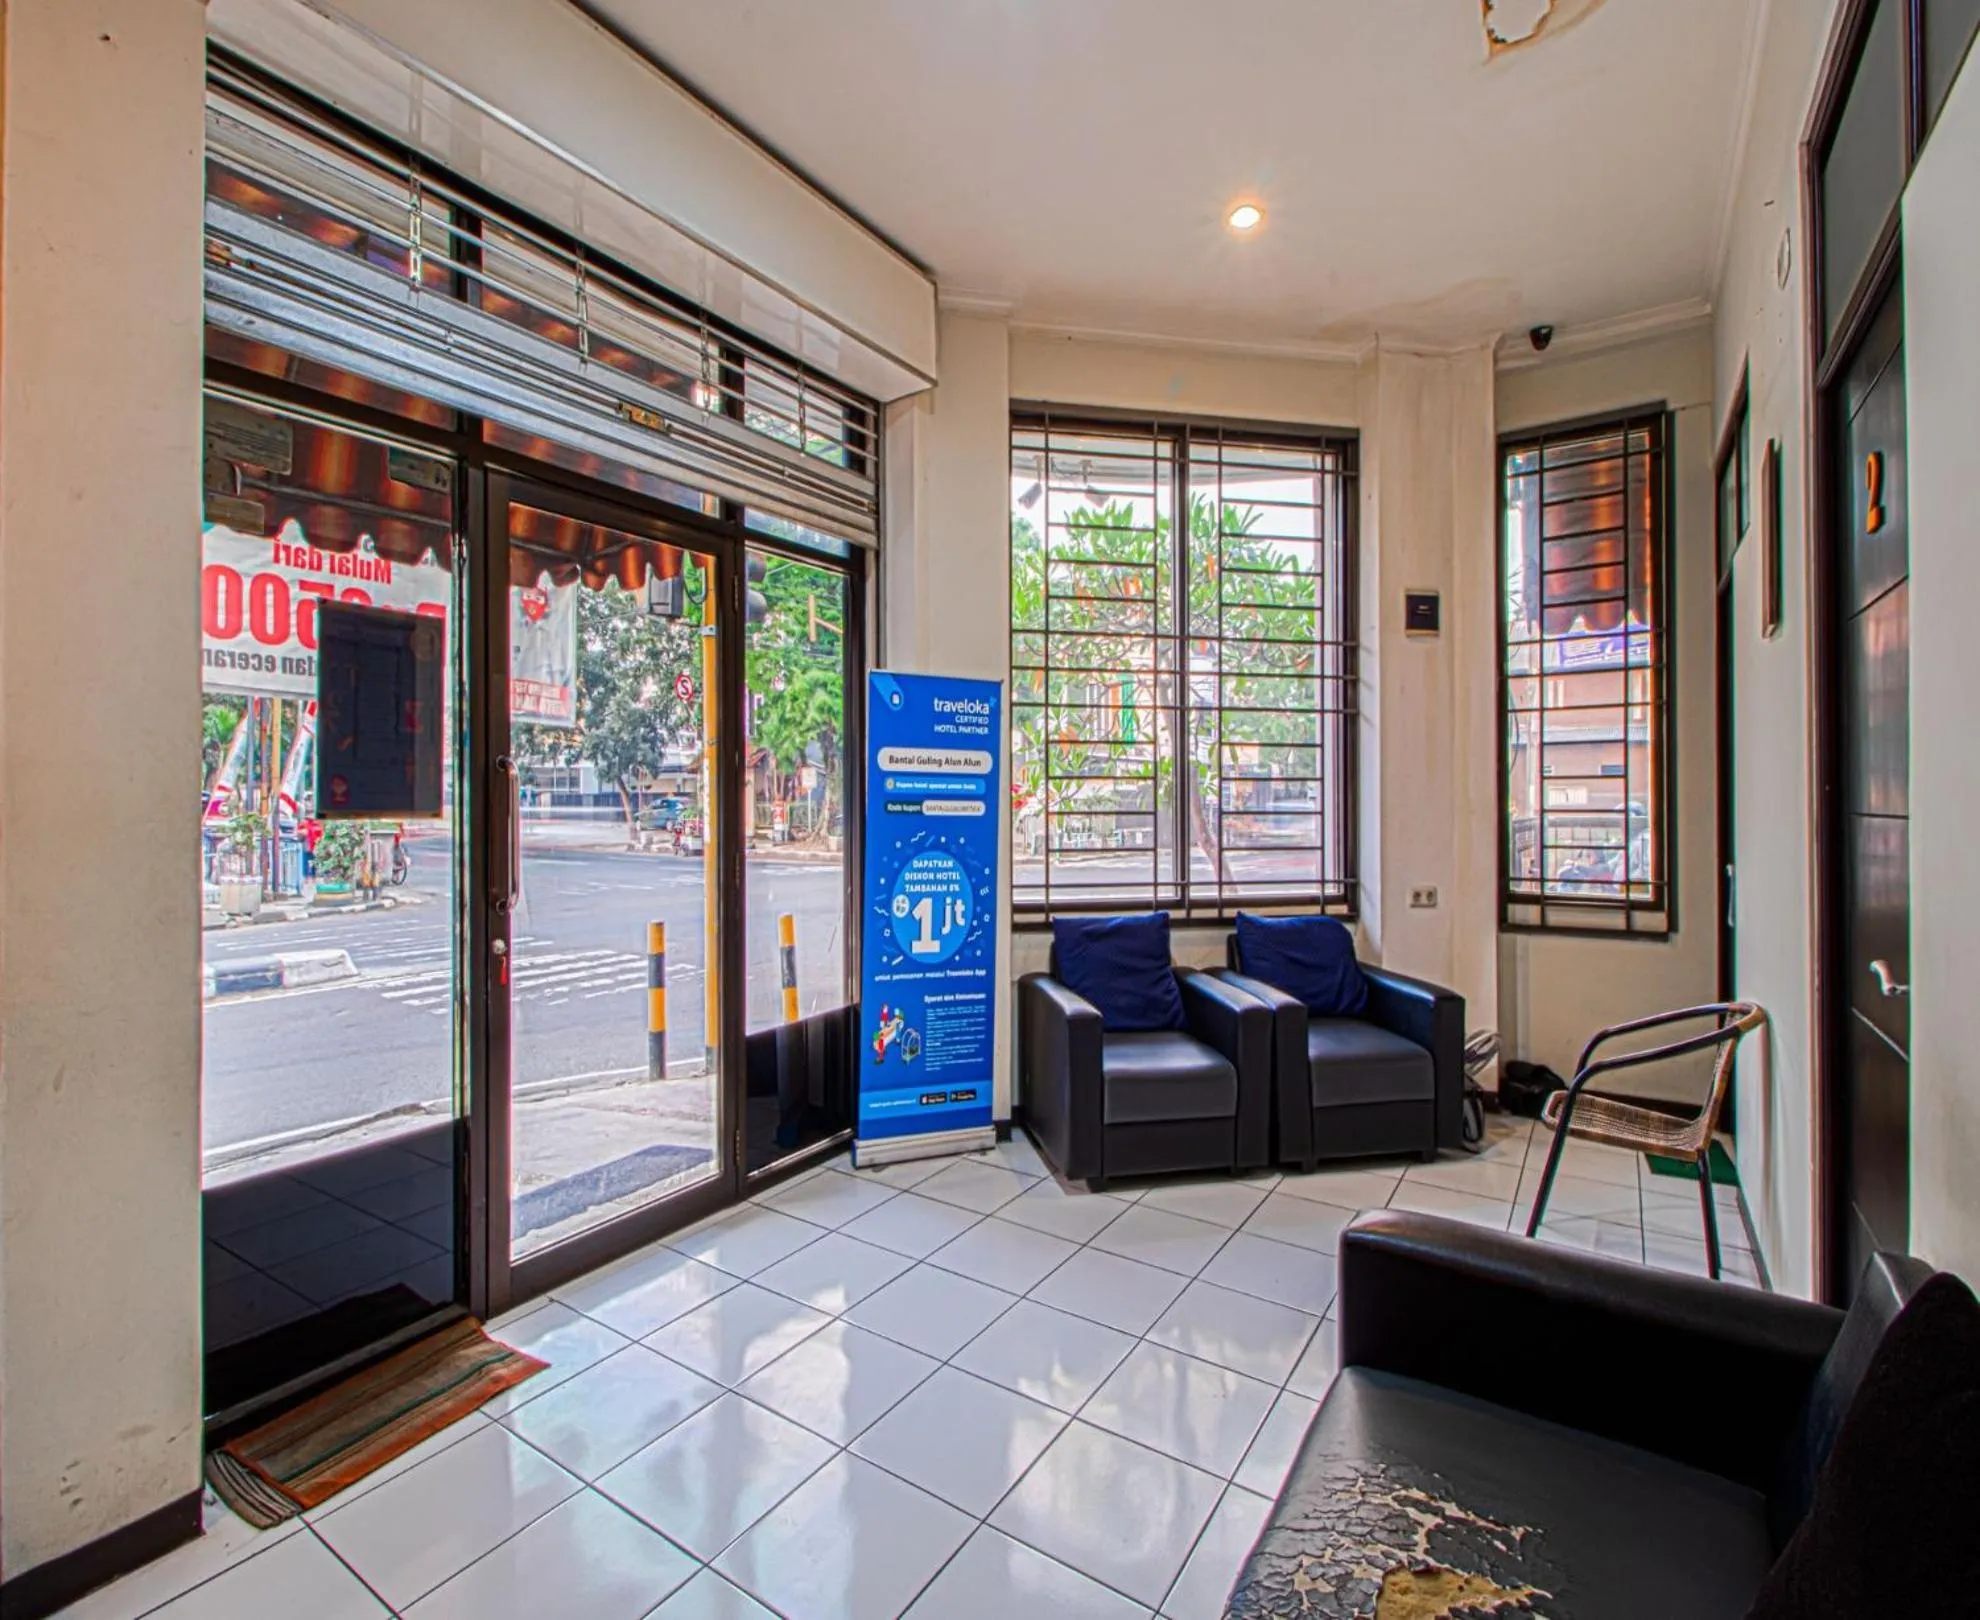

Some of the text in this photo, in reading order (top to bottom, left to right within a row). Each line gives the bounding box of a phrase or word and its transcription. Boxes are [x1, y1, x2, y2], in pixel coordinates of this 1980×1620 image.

[1864, 451, 1882, 535] 2
[680, 679, 689, 696] S
[933, 697, 990, 715] traveloka
[955, 715, 989, 725] CERTIFIED
[934, 724, 989, 735] HOTEL PARTNER
[904, 871, 961, 880] DISKON HOTEL
[911, 897, 941, 953] 1
[941, 896, 966, 935] jt
